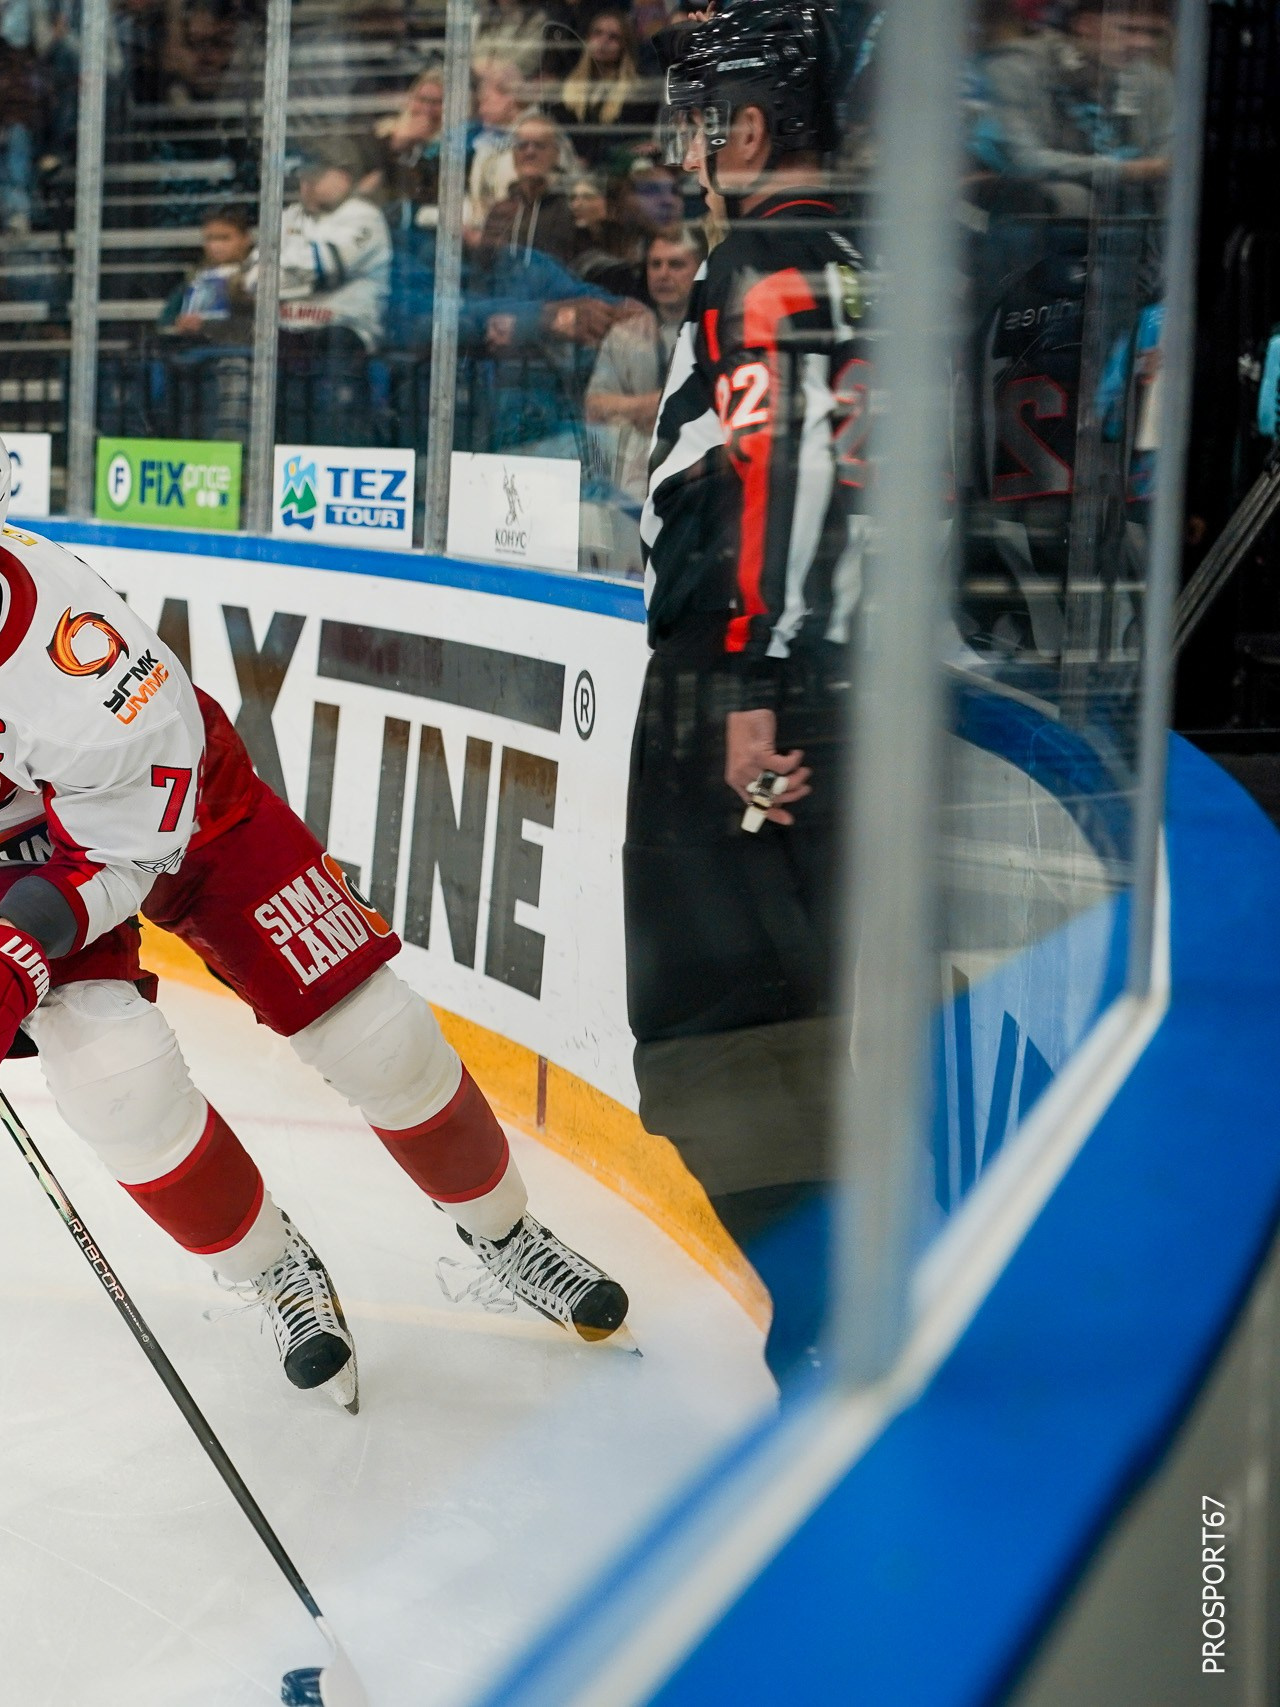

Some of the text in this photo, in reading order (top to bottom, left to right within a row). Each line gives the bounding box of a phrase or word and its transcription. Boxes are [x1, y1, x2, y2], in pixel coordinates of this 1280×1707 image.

[326, 467, 407, 502] TEZ
[329, 506, 399, 528] TOUR
[116, 662, 169, 725] UMMC
[150, 760, 201, 833] 7
[303, 700, 560, 1001] LINE
[254, 865, 343, 946] SIMA
[280, 902, 369, 986] LAND
[68, 1217, 125, 1302] RIBCOR
